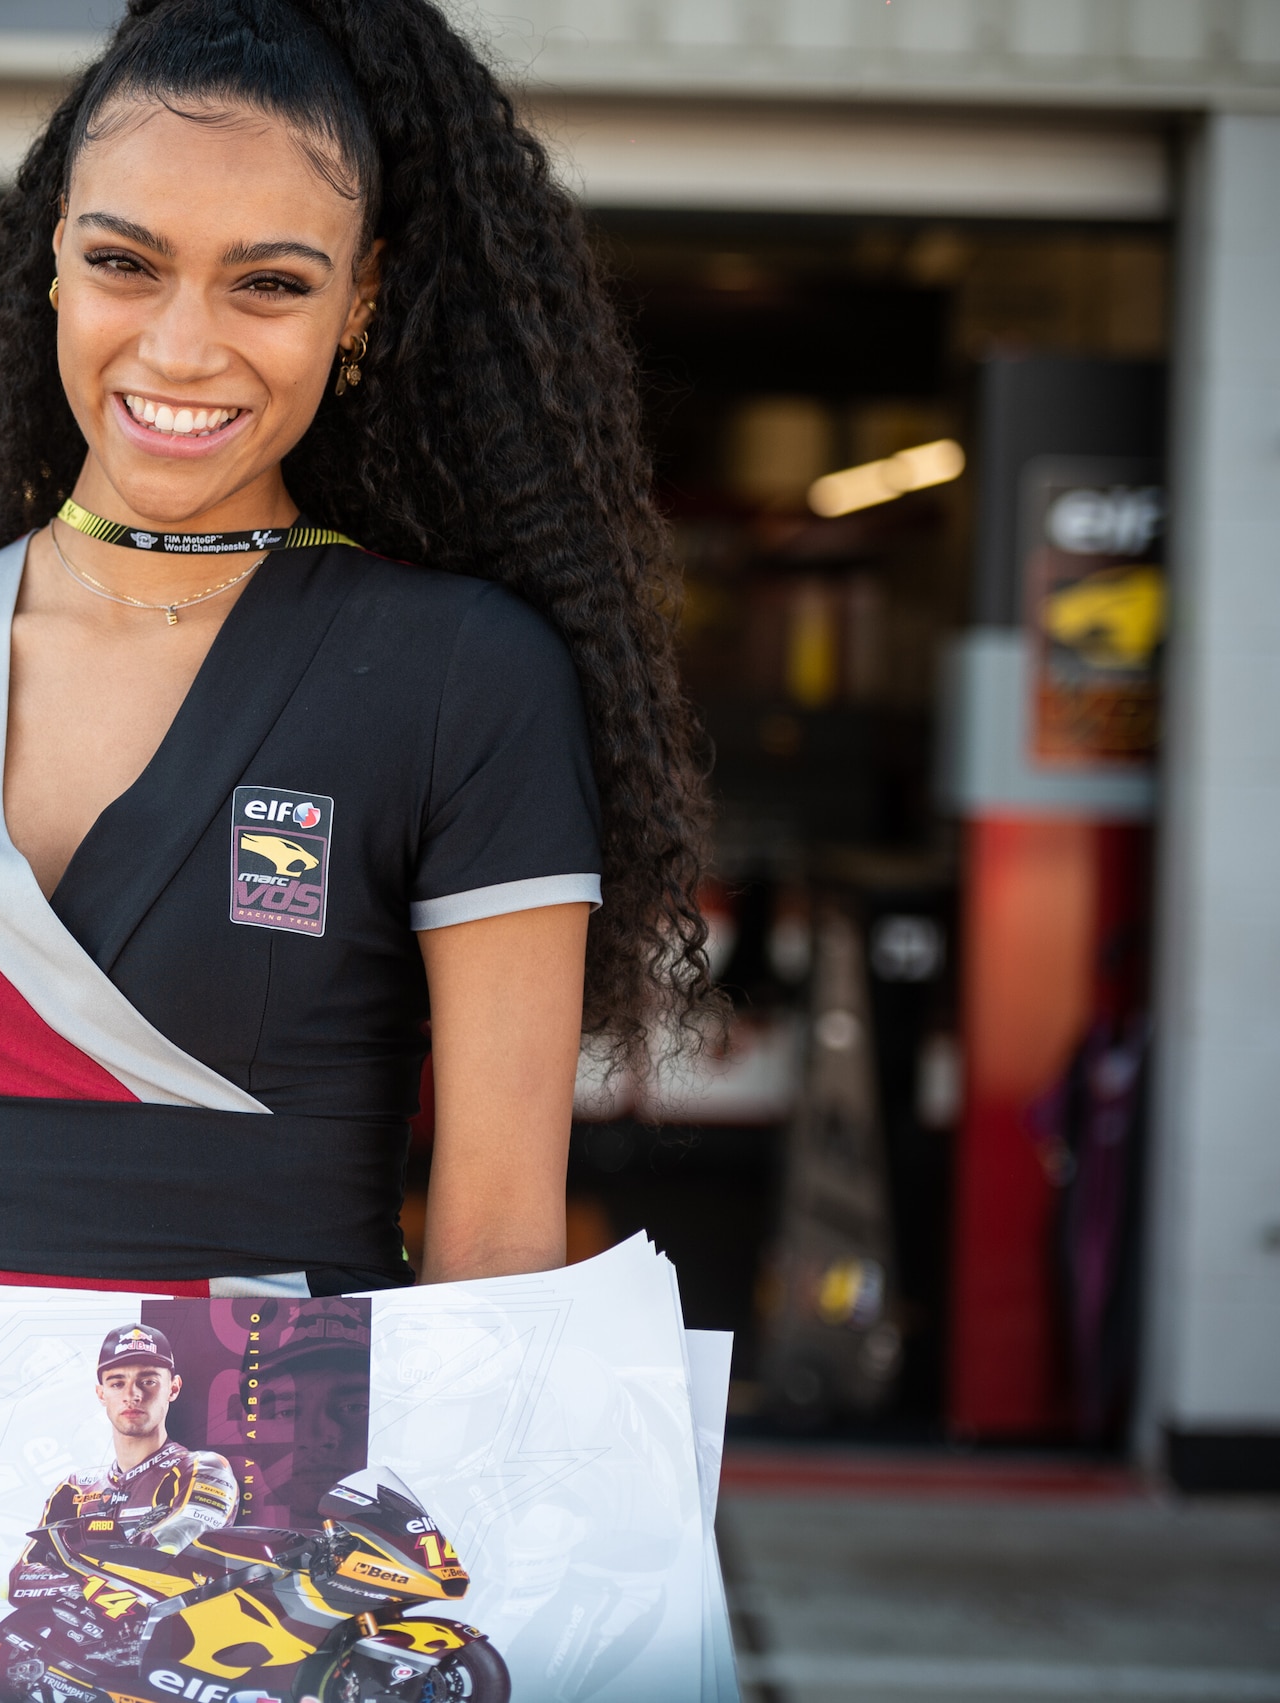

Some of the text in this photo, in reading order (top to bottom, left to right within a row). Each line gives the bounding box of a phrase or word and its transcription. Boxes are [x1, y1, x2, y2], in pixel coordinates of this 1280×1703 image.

[164, 535, 181, 544] FIM
[164, 542, 250, 554] World Championship
[244, 798, 294, 822] elf
[238, 872, 289, 887] marc
[238, 910, 282, 921] RACING
[136, 1340, 157, 1354] Bull
[242, 1313, 260, 1515] TONY ARBOLINO
[125, 1445, 178, 1481] DAINESE
[88, 1520, 114, 1531] ARBO
[368, 1565, 410, 1585] Beta
[82, 1574, 139, 1620] 14
[43, 1675, 84, 1698] TRIUMPH
[148, 1669, 232, 1703] elf
